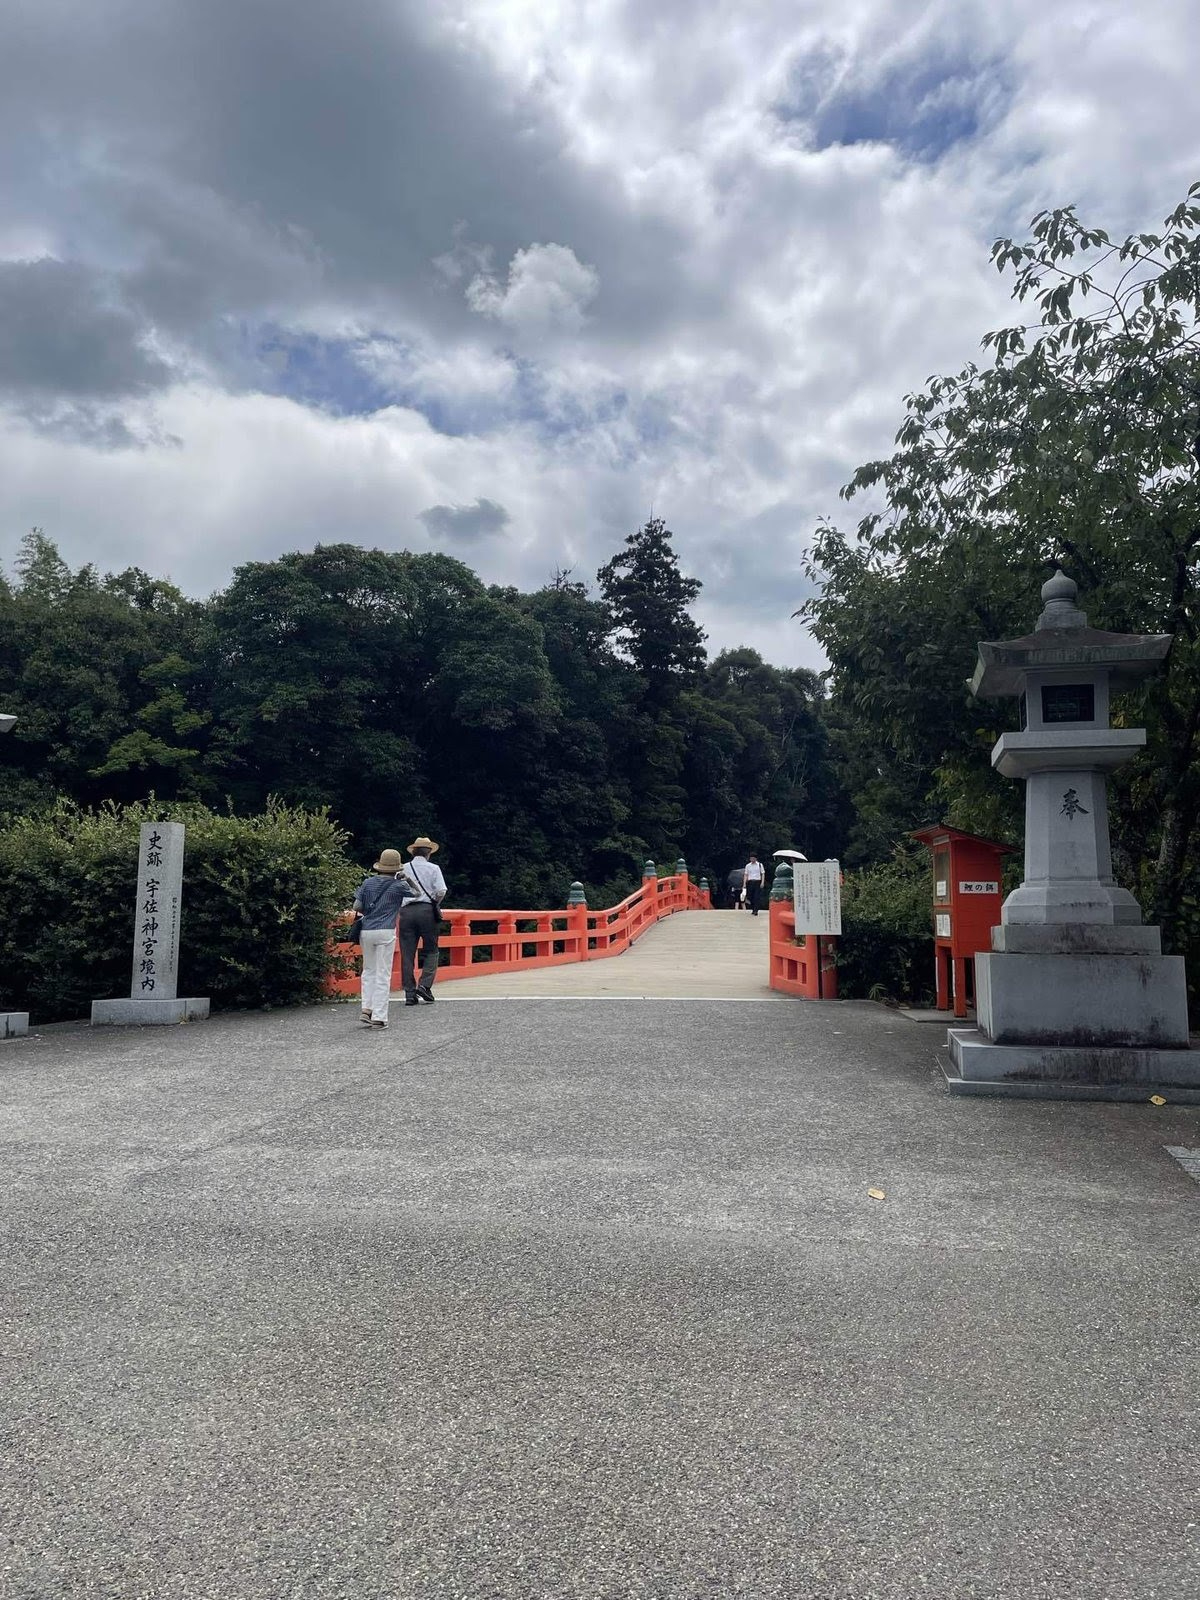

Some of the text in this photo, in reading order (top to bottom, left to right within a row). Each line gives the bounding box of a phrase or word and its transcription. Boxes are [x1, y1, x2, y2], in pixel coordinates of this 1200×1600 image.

[1060, 788, 1089, 821] 奉
[140, 831, 162, 991] 史跡 宇佐神宮境内
